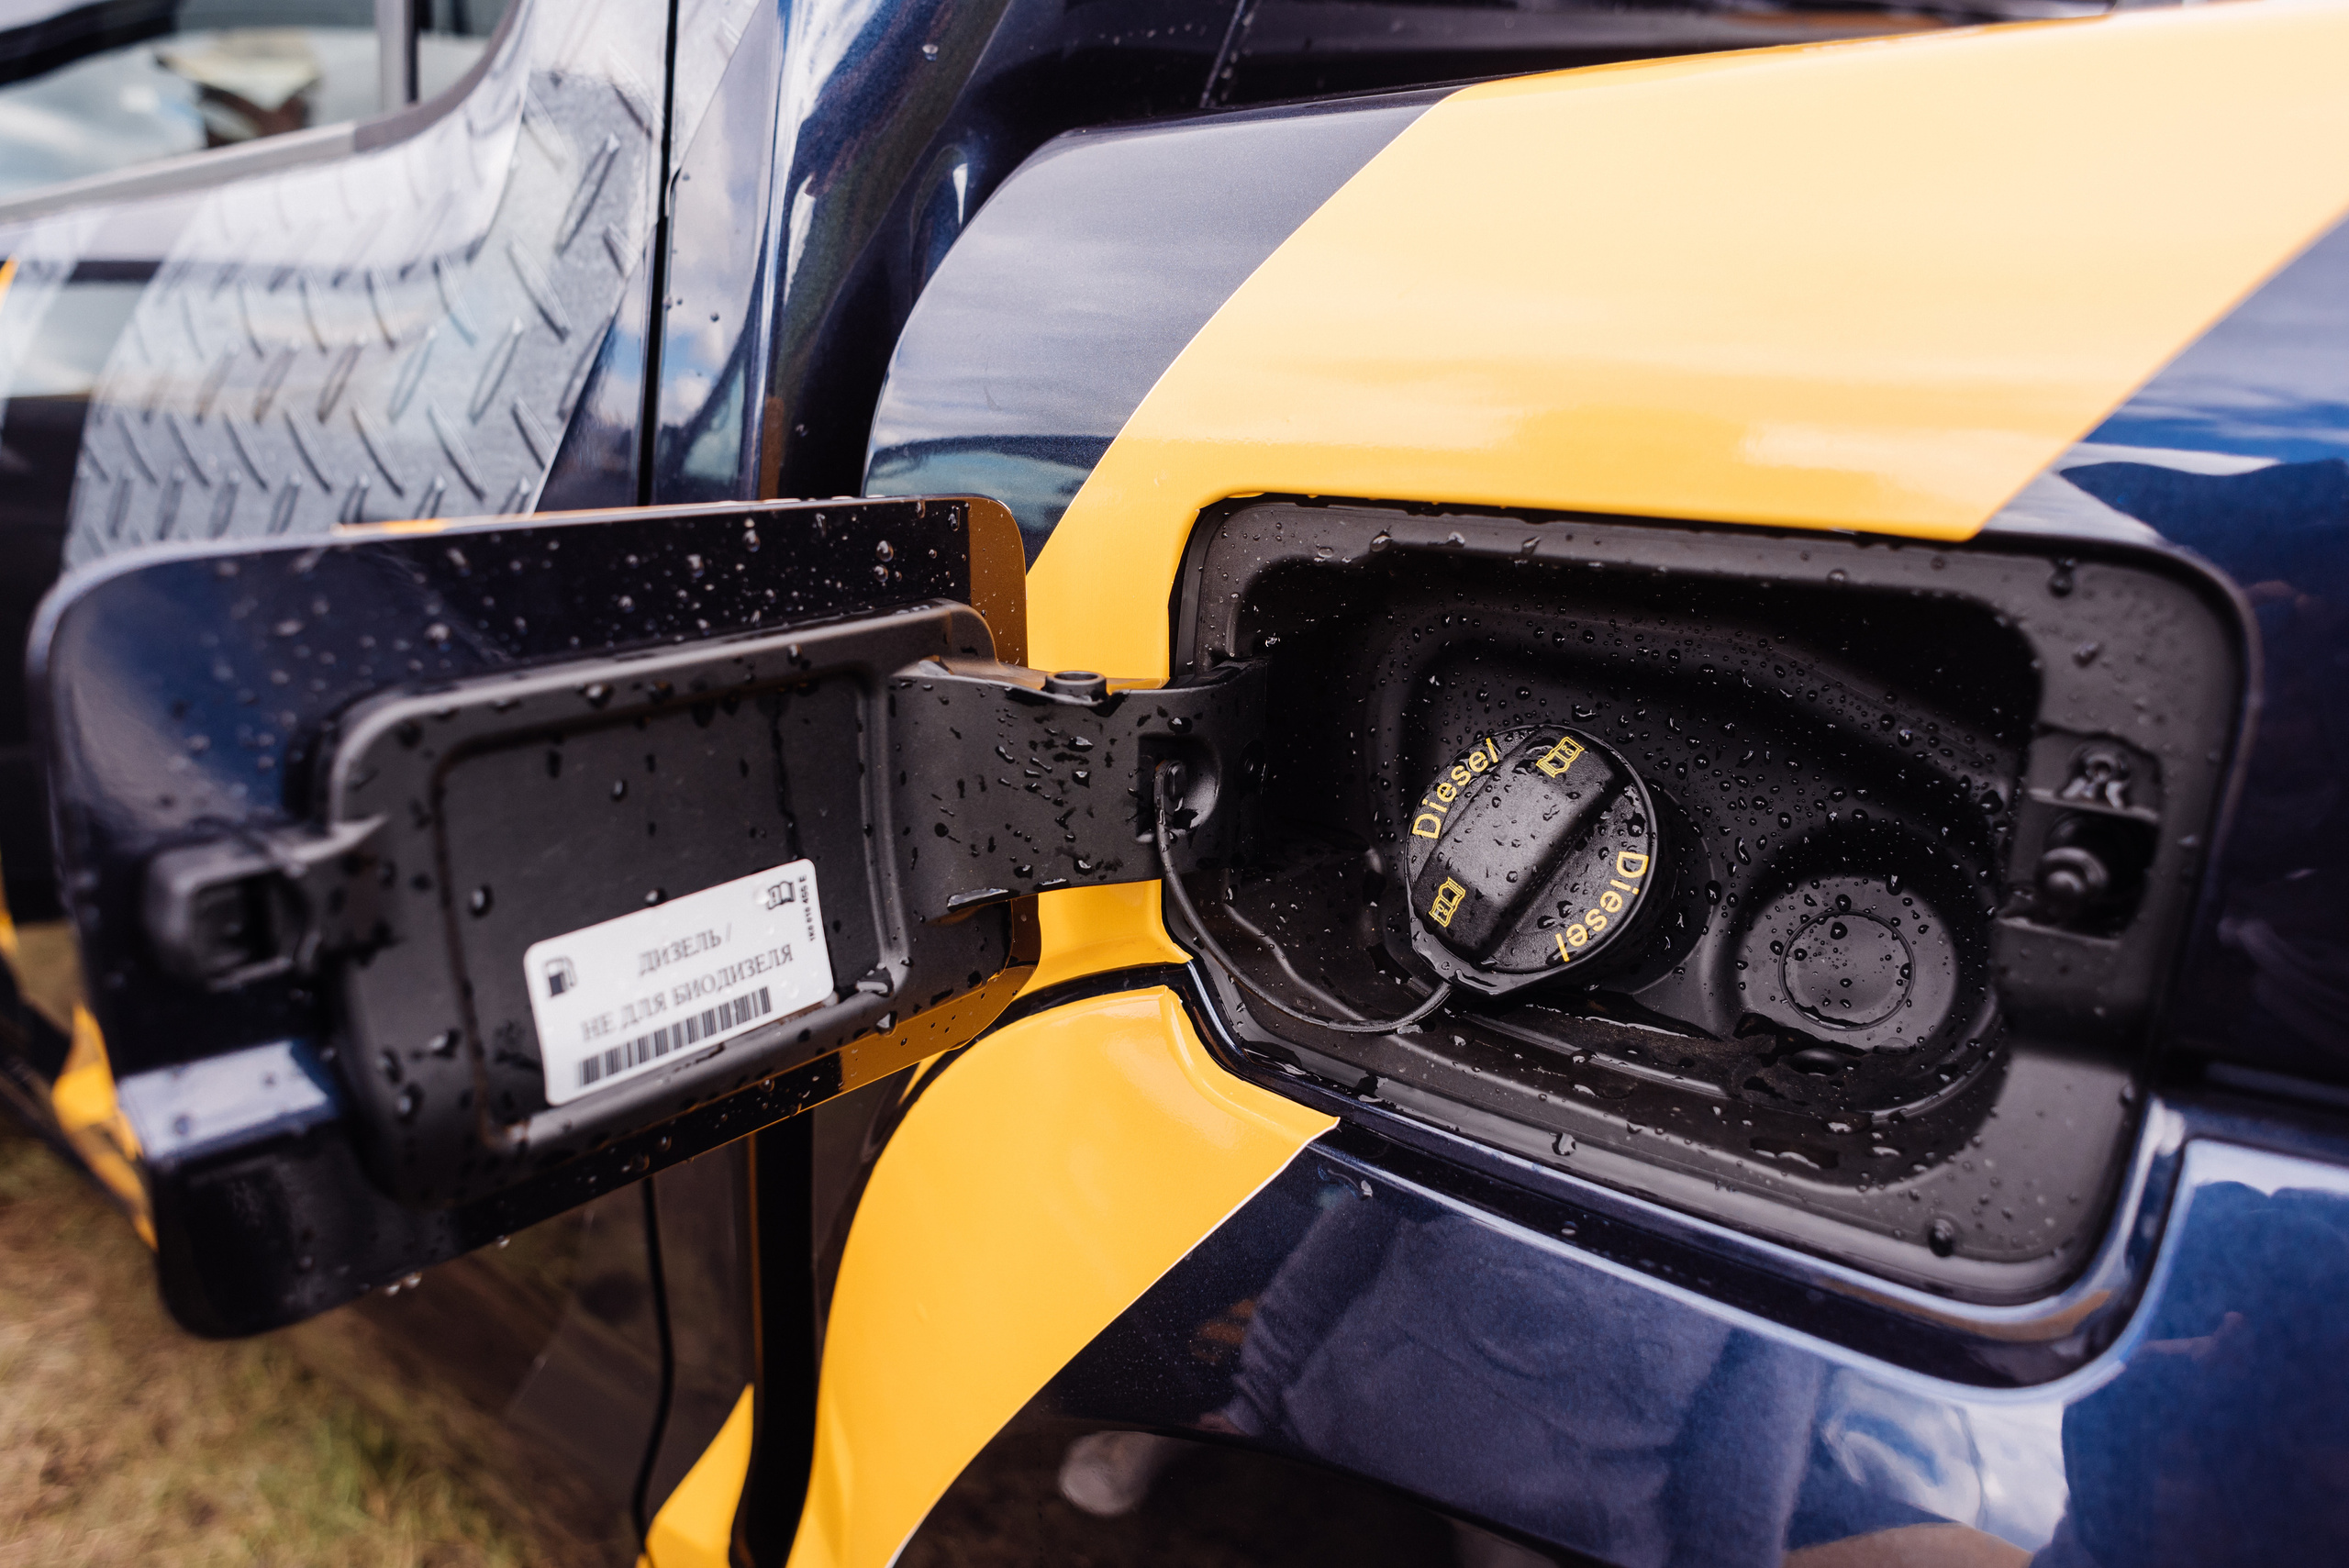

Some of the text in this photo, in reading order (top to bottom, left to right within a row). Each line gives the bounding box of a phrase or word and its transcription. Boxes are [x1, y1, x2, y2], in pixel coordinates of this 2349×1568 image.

[1412, 738, 1498, 839] Diesel
[638, 928, 721, 978] ДИЗЕЛЬ
[1555, 851, 1649, 962] Diesel
[581, 943, 795, 1042] НЕ ДЛЯ БИОДИЗЕЛЯ
